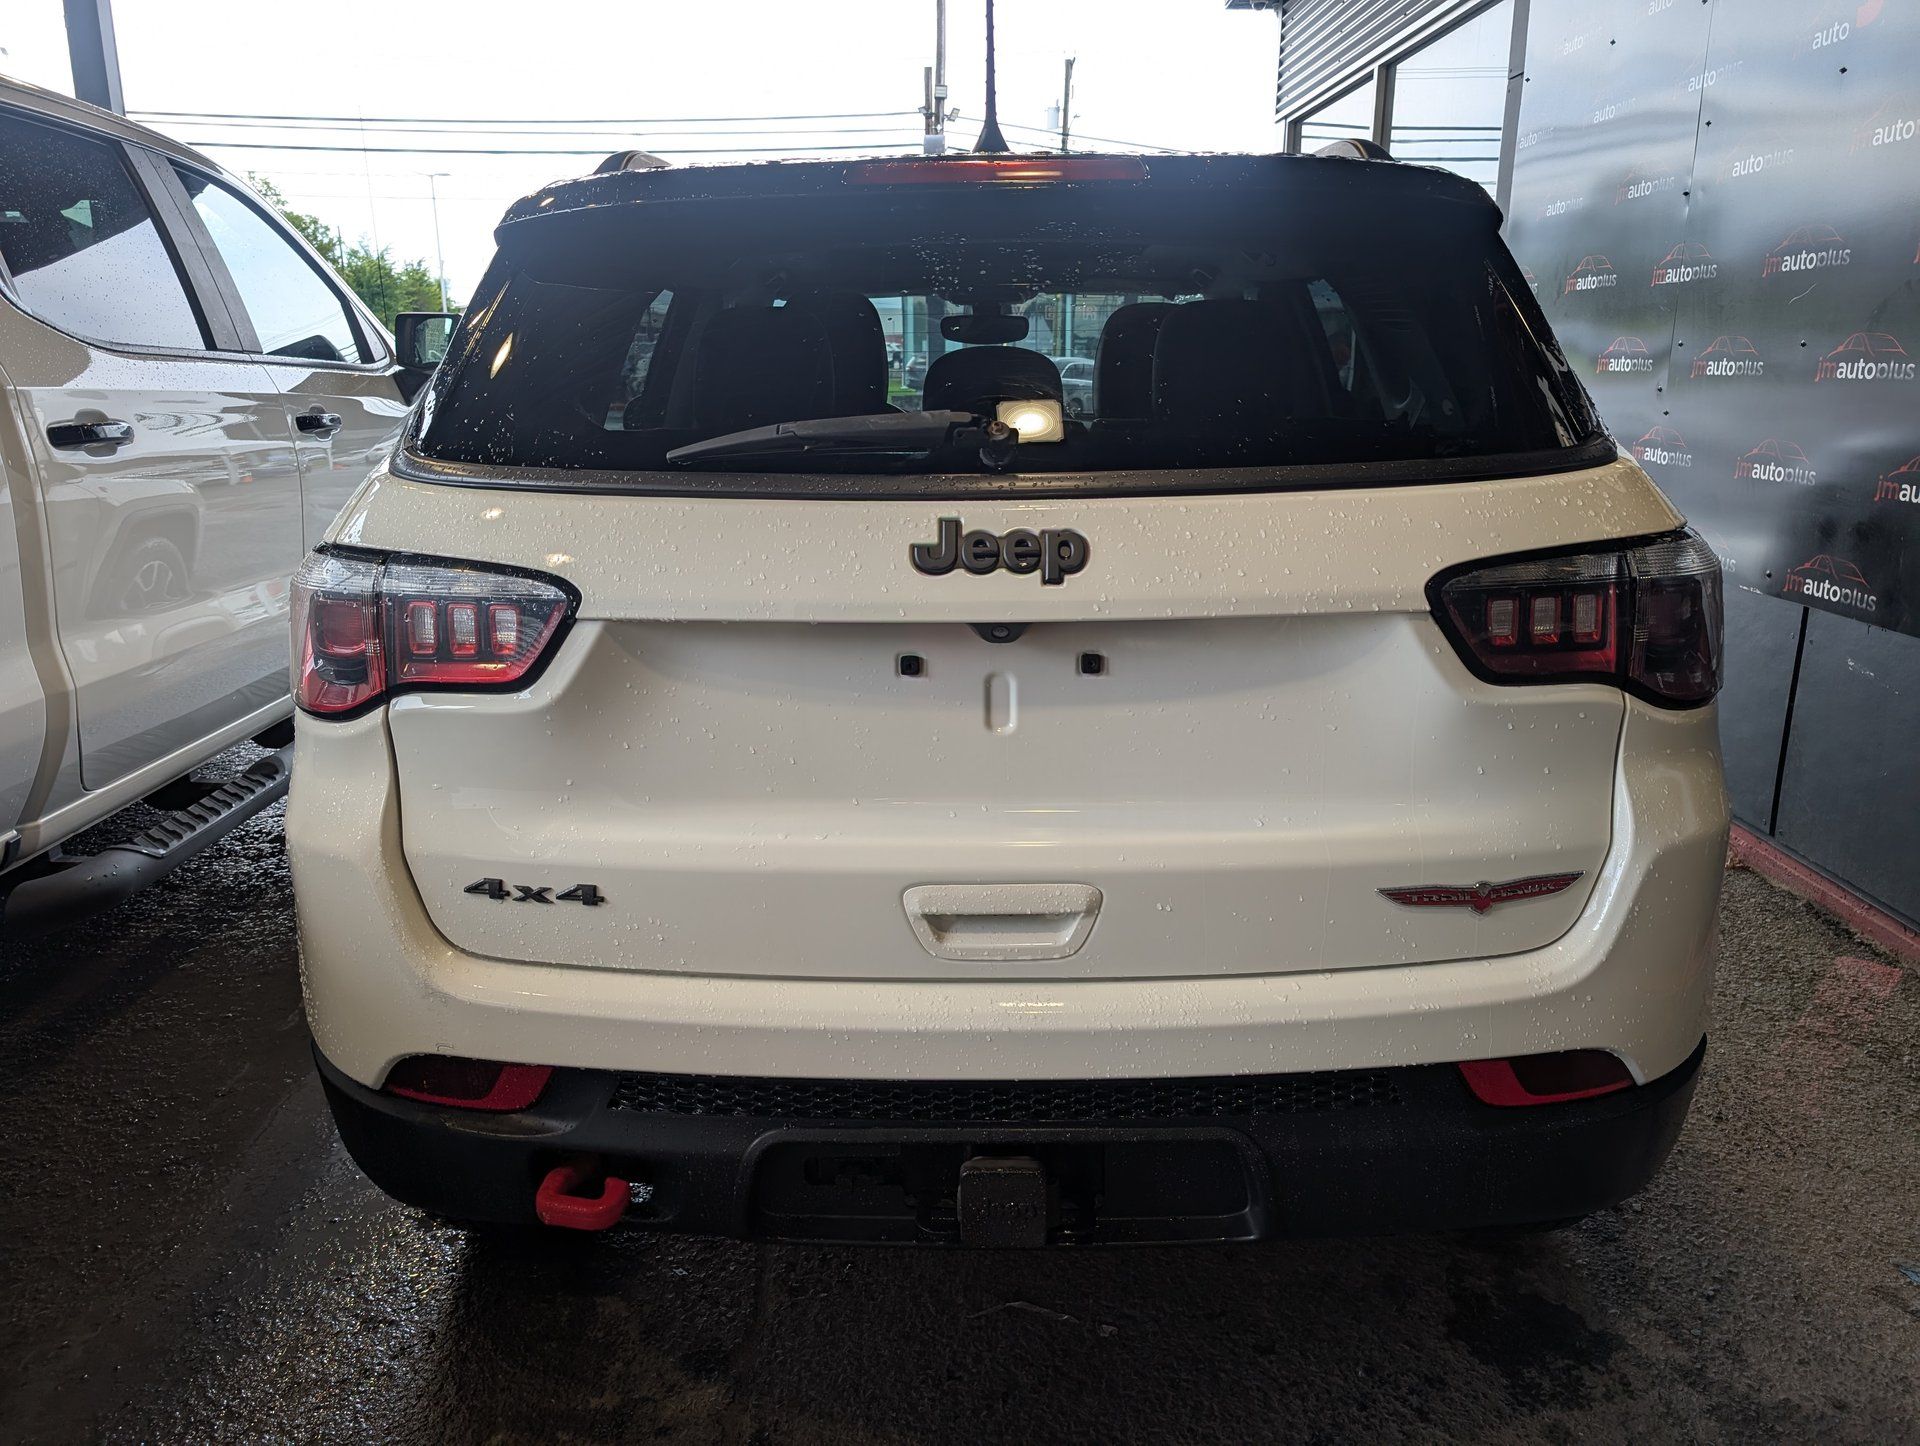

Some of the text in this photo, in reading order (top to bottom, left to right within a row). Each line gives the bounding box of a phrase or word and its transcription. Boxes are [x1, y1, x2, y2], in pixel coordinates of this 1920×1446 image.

[1650, 262, 1718, 287] jmautoplus
[1762, 246, 1851, 278] jmautoplus
[1565, 273, 1617, 295] jmautoplus
[1596, 354, 1653, 377] jmautoplus
[1690, 356, 1764, 379] jmautoplus
[1814, 357, 1916, 384] jmautoplus
[1632, 443, 1692, 468] jmautoplus
[1733, 456, 1816, 487] jmautoplus
[910, 517, 1091, 587] Jeep
[1783, 569, 1877, 612] jmautoplus
